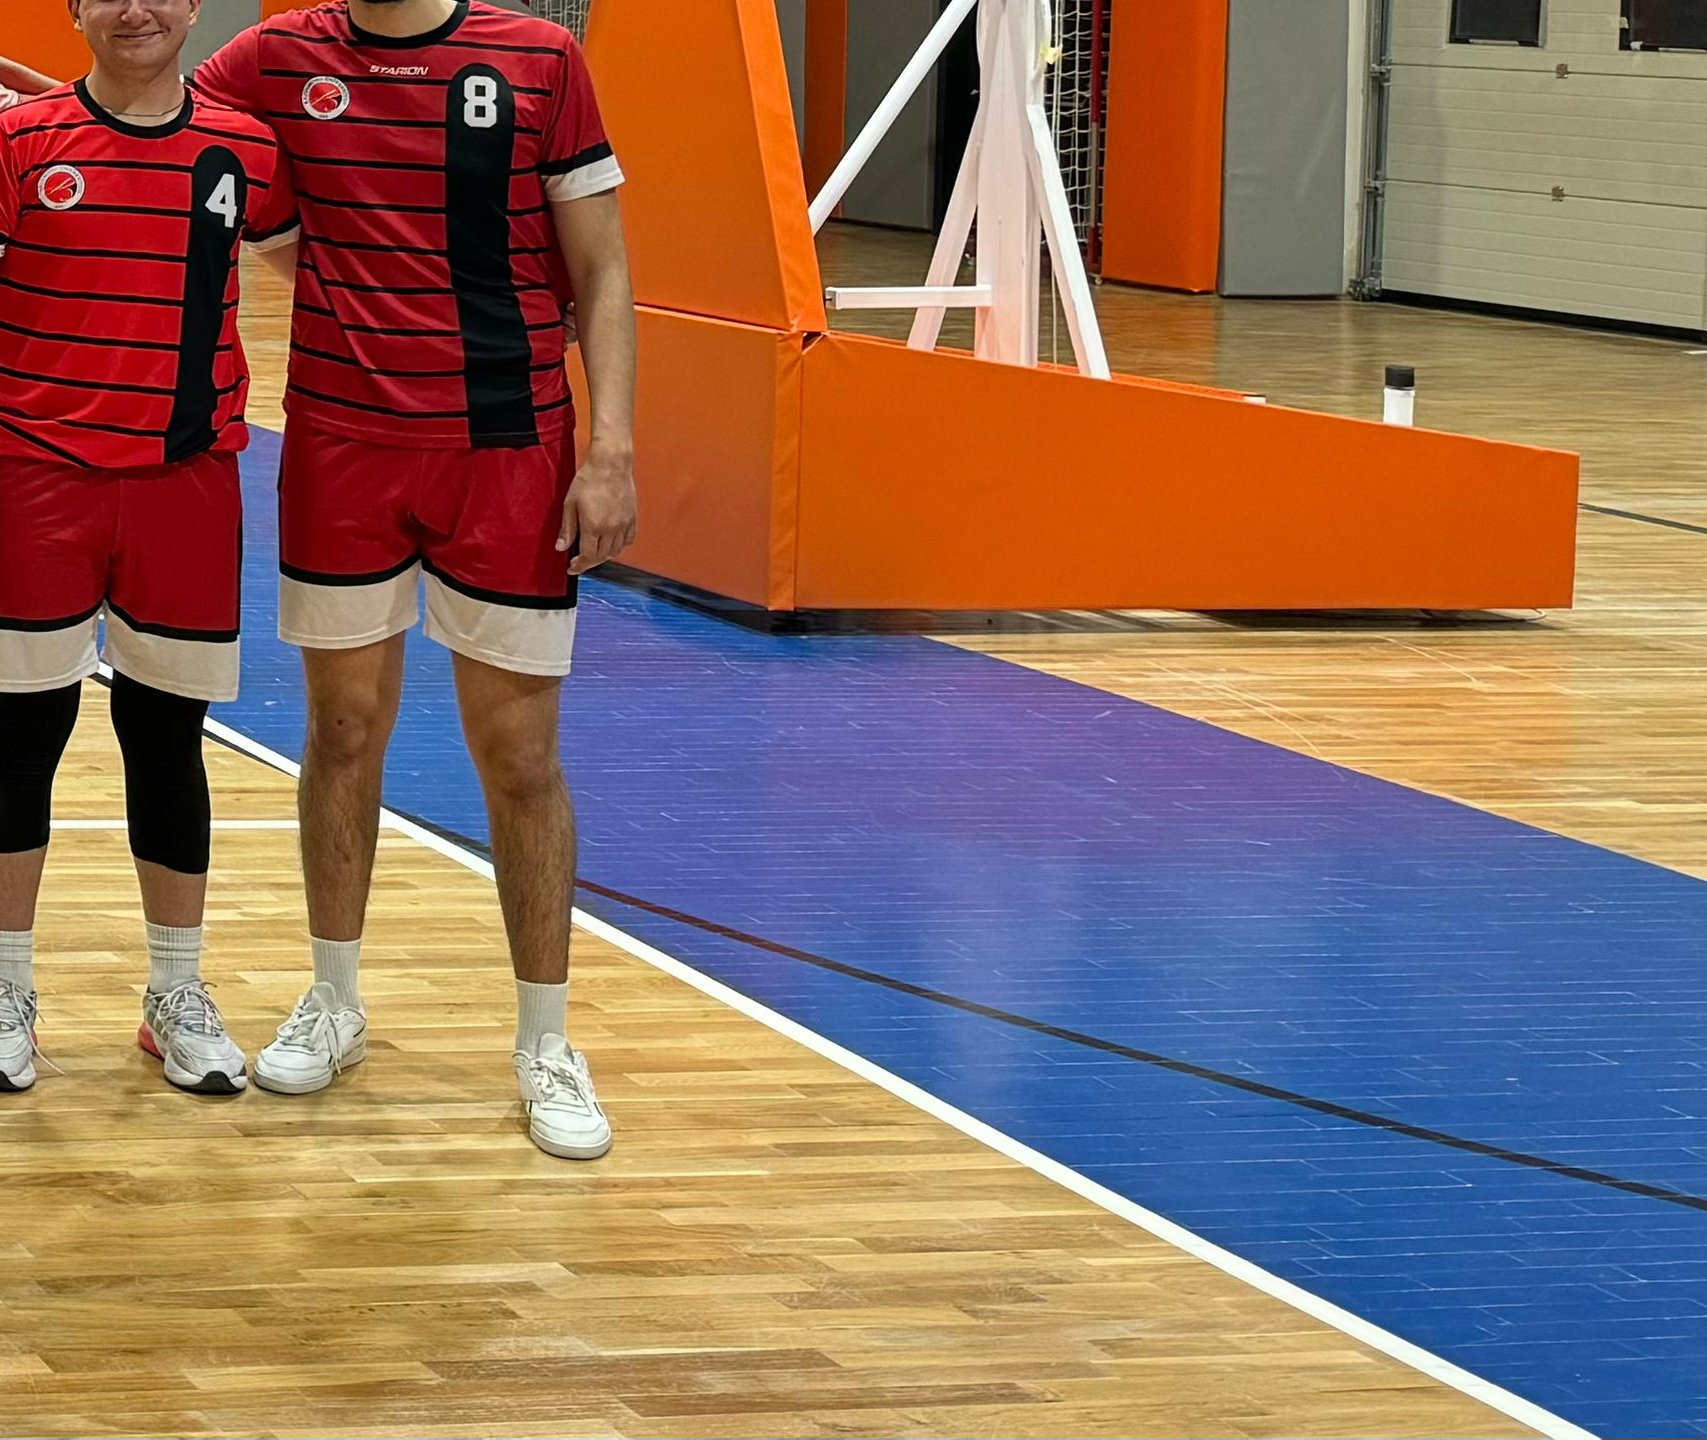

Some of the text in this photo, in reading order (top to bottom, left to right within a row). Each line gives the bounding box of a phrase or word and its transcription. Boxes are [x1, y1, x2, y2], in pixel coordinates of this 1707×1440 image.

[369, 64, 429, 76] STARION
[463, 75, 498, 128] 8
[204, 173, 238, 229] 4
